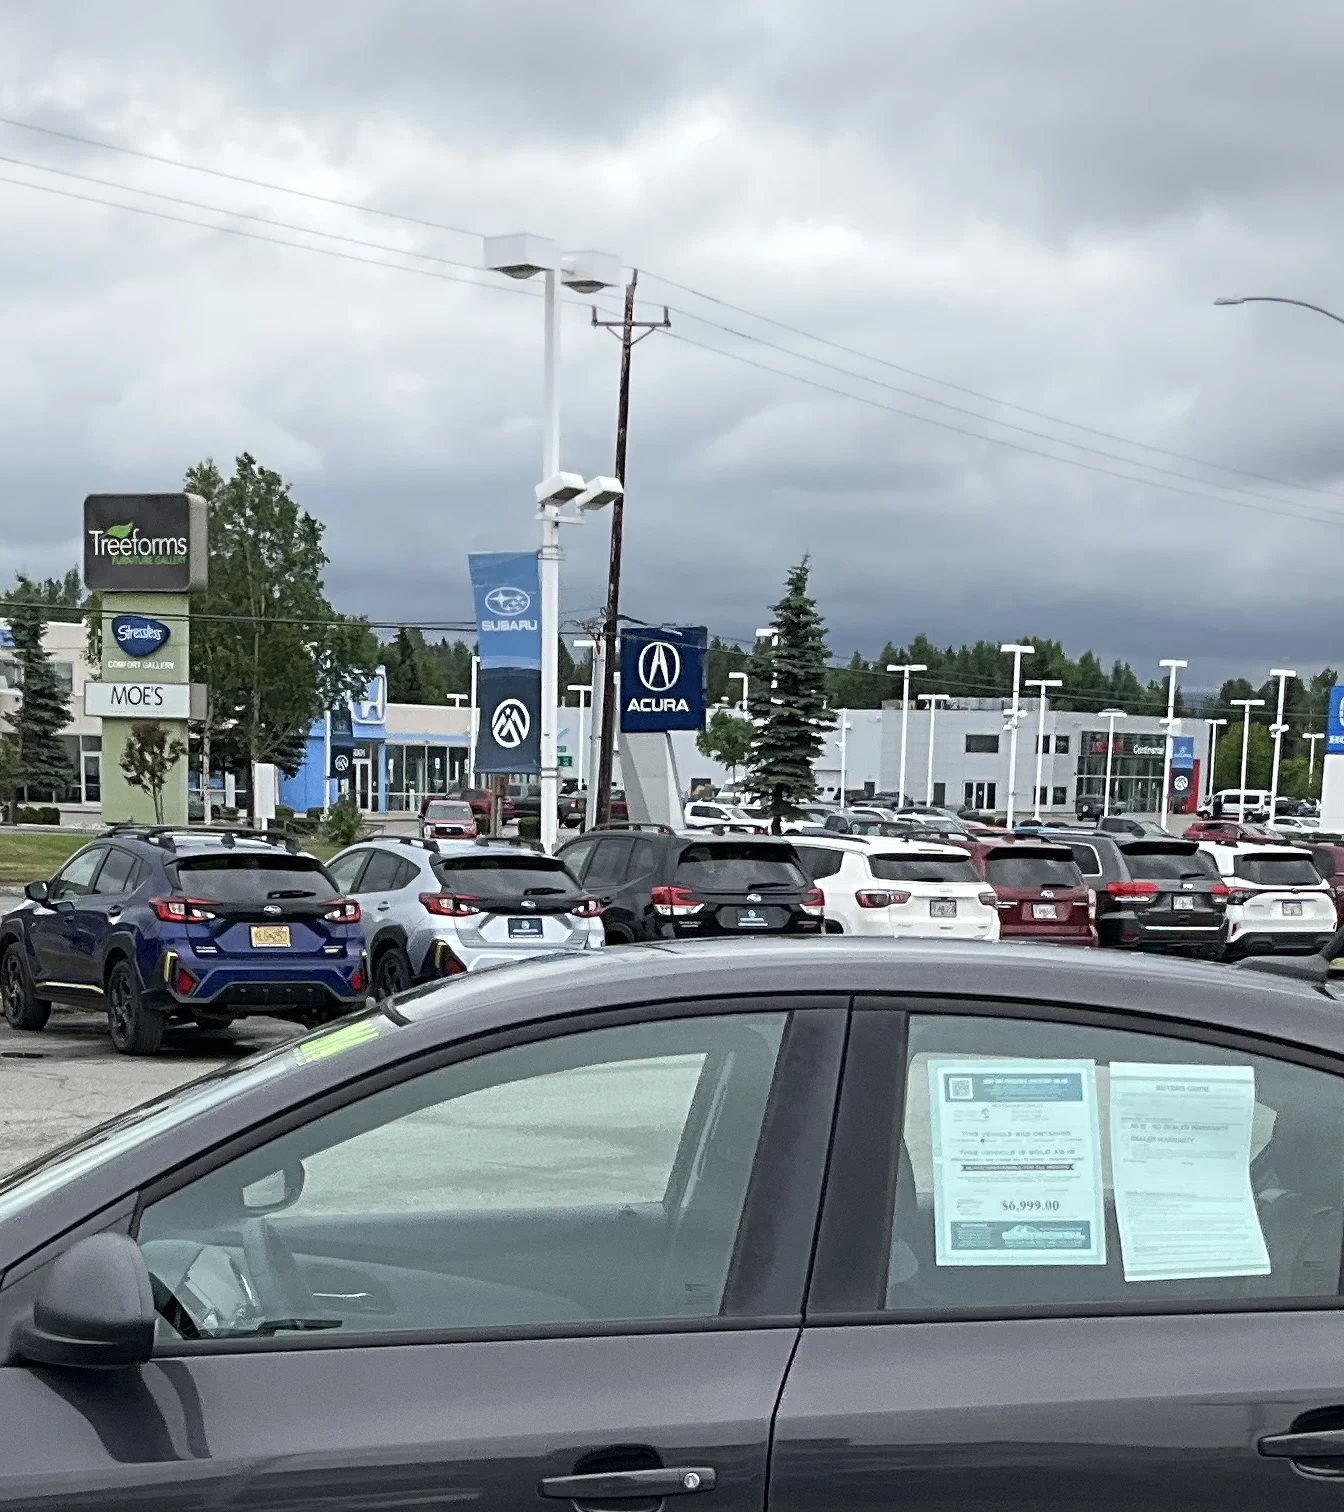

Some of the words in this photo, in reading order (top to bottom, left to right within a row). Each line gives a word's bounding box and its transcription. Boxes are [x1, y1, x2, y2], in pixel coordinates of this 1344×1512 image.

[88, 528, 187, 556] Treeforms
[117, 624, 163, 641] Stressless
[481, 619, 538, 631] SUBARU
[107, 660, 141, 669] COMFORT
[142, 661, 175, 670] GALLERY
[110, 685, 164, 706] MOE'S
[627, 698, 690, 713] ACURA
[1001, 1199, 1060, 1213] $6,999.00
